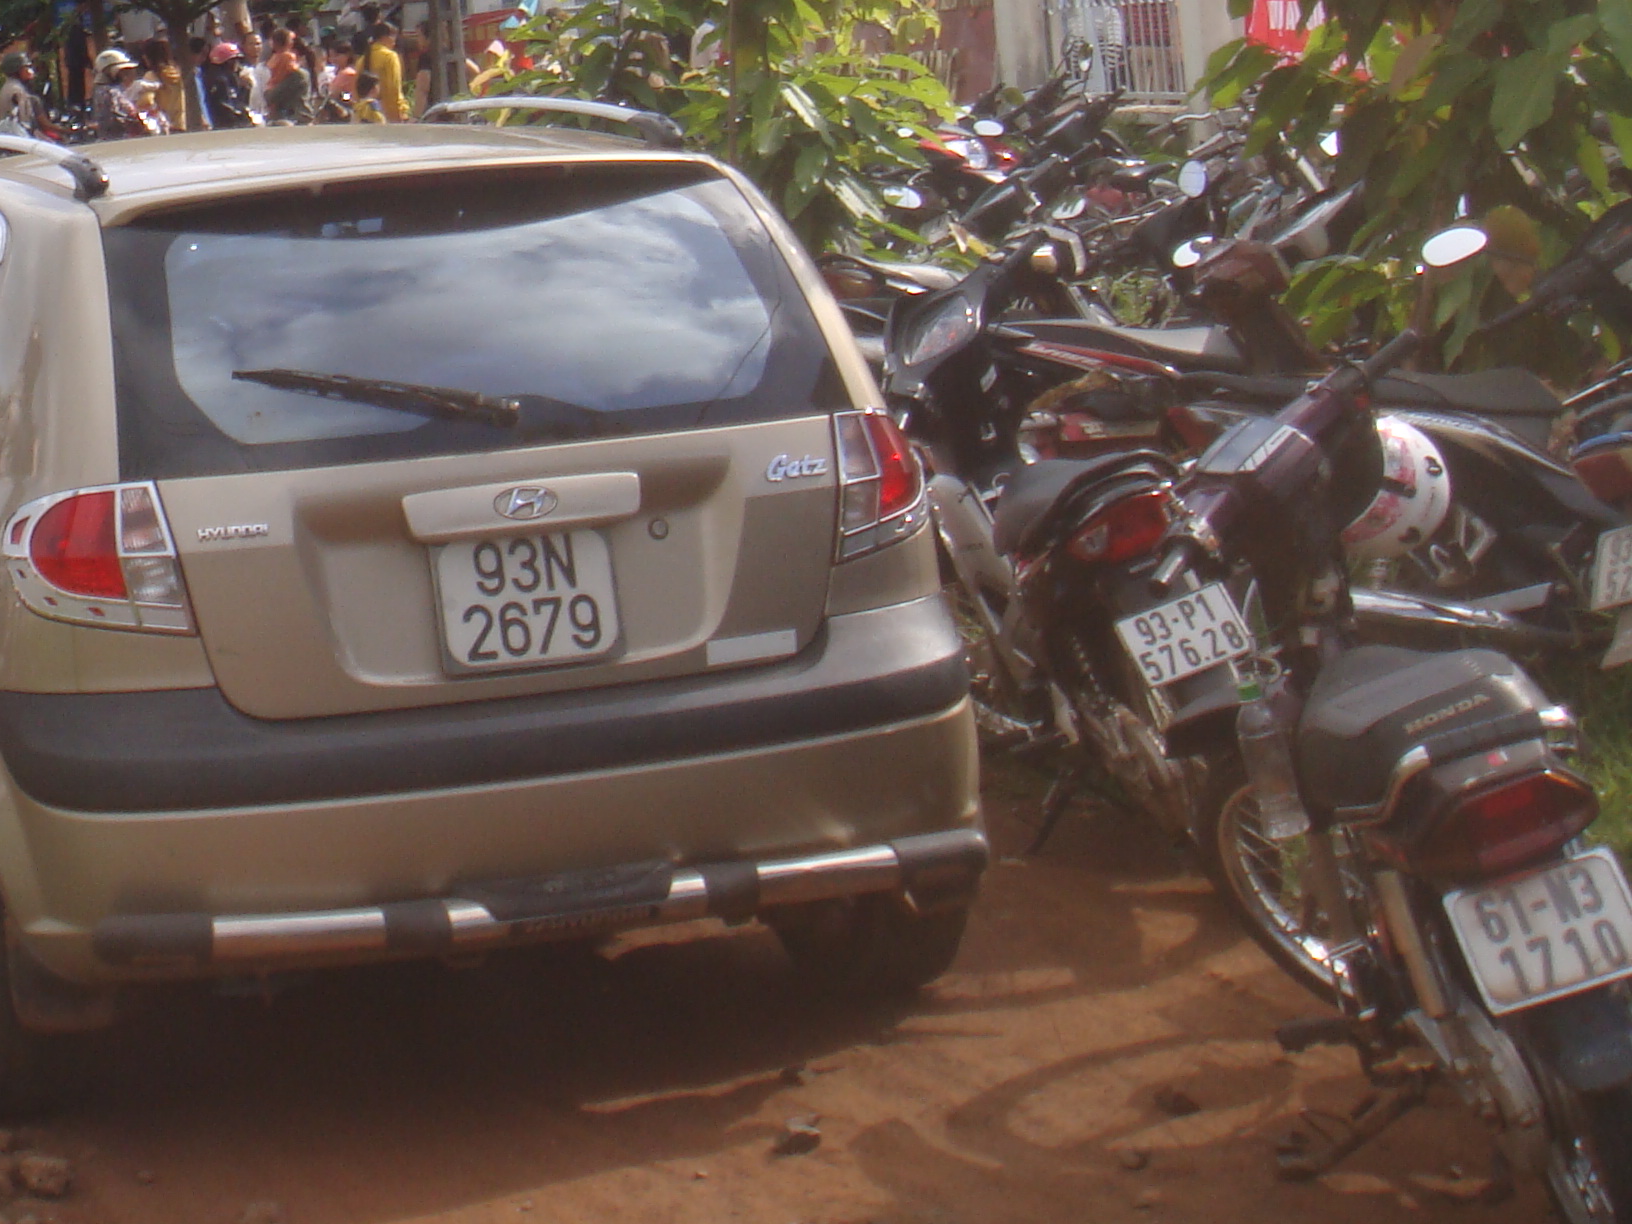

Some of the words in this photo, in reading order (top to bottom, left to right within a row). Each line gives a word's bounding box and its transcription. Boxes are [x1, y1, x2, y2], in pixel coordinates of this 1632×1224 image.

[766, 454, 829, 482] Getz
[196, 523, 269, 540] HYUNDAI
[472, 533, 578, 596] 93N
[462, 593, 602, 662] 2679
[1134, 593, 1216, 646] 93-P1
[1138, 619, 1245, 682] 576.28
[1498, 918, 1629, 995] 1710
